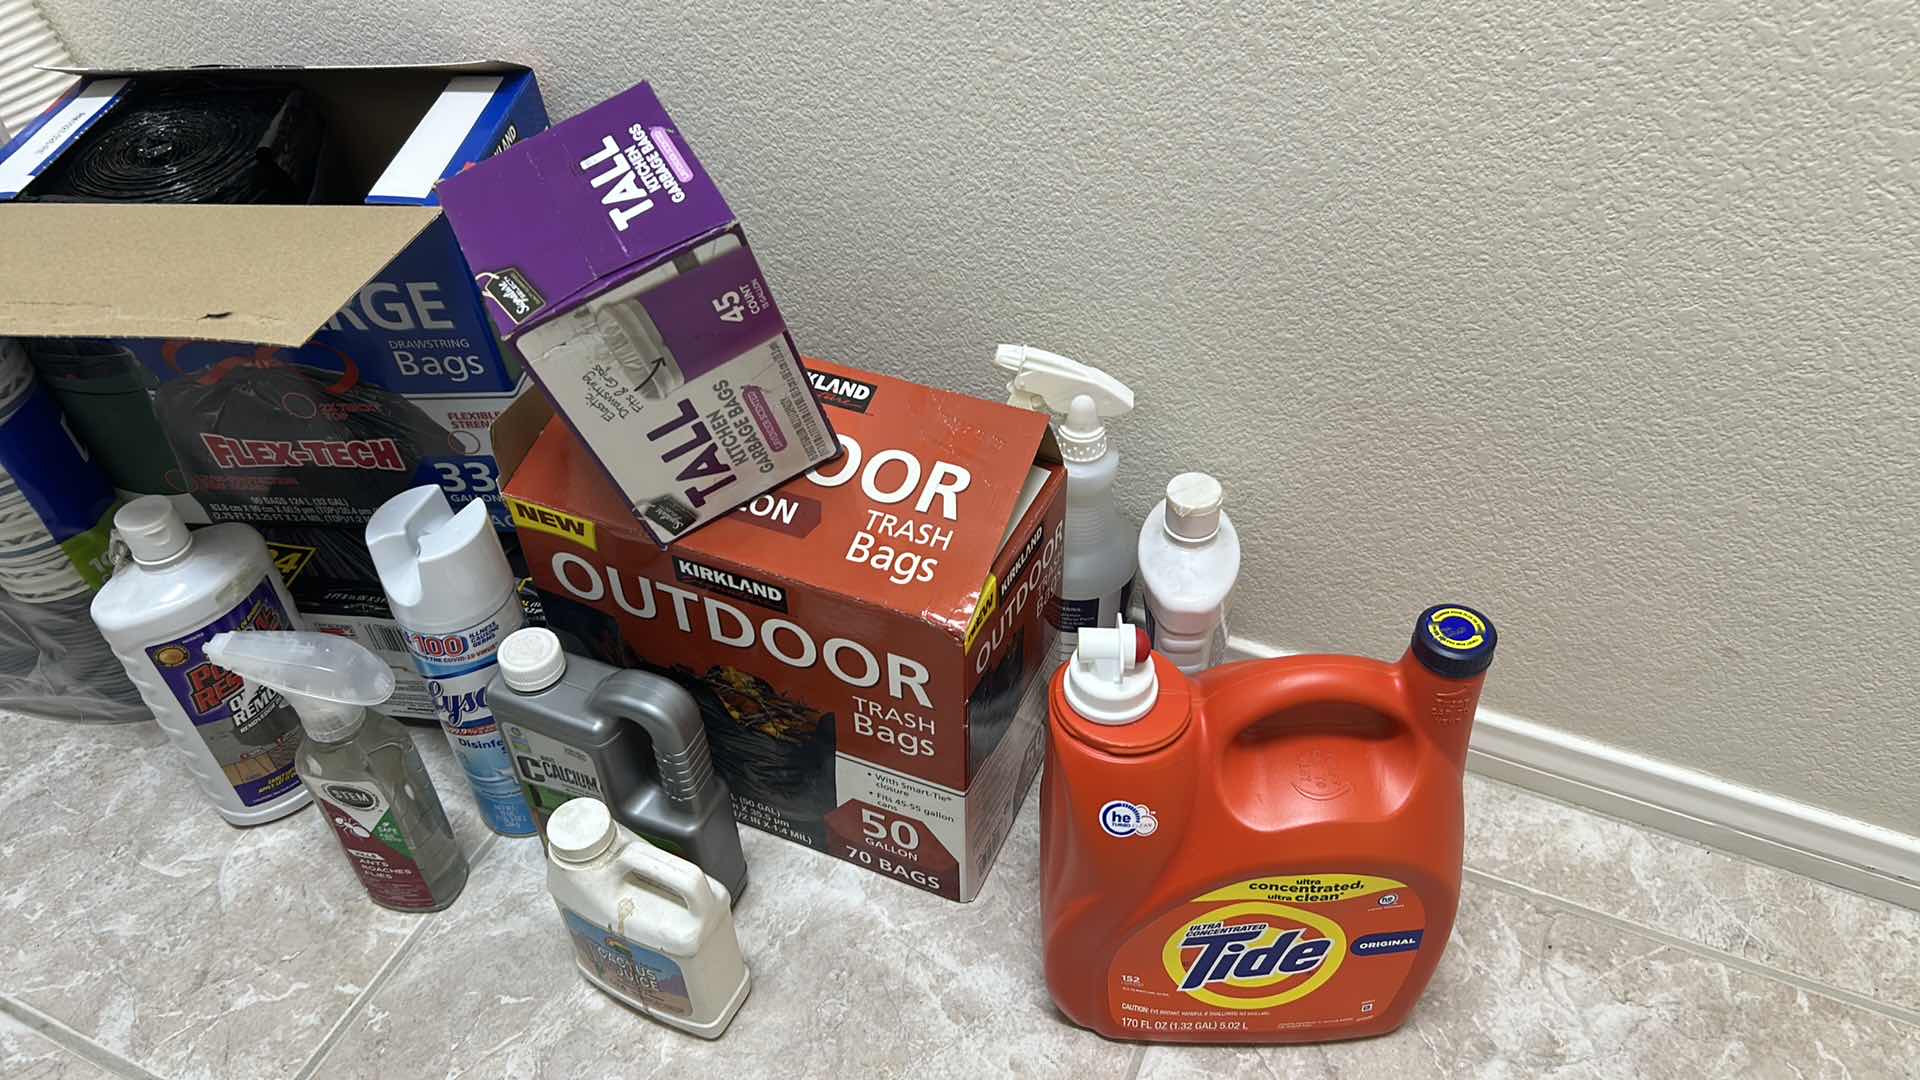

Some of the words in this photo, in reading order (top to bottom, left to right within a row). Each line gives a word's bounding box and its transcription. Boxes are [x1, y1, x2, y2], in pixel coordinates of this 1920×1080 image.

[628, 123, 662, 156] BAGS
[579, 135, 654, 231] TALL
[624, 145, 661, 194] KITCHEN
[643, 153, 686, 203] GARBAGE
[331, 282, 454, 331] RGE
[711, 290, 745, 326] 45
[738, 285, 761, 316] COUNT
[388, 338, 470, 350] DRAWSTRING
[393, 351, 485, 382] Bags
[593, 364, 622, 390] Grips
[581, 375, 630, 418] Drawstring
[584, 393, 615, 423] Elastic
[627, 393, 644, 413] Fits
[711, 378, 746, 414] BAGS
[451, 420, 490, 430] STREN
[199, 432, 405, 471] FLEX-TECH
[645, 397, 738, 508] TALL
[706, 409, 750, 474] KITCHEN
[732, 414, 776, 474] GARBAGE
[433, 461, 497, 493] 33
[514, 502, 585, 538] NEW
[866, 508, 954, 552] TRASH
[845, 530, 939, 585] Bags
[1001, 525, 1043, 596] KIRKLAND
[679, 559, 783, 602] KIRKLAND
[976, 519, 1063, 675] OUTDOOR
[550, 551, 934, 709] OUTDOOR
[968, 592, 994, 643] NEW
[414, 632, 469, 658] 100
[428, 680, 489, 727] Lyso
[851, 695, 937, 737] TRASH
[853, 712, 936, 760] Bags
[541, 761, 600, 793] CALCIUM
[874, 773, 899, 788] With
[874, 782, 910, 798] closure
[330, 789, 370, 805] STEM
[757, 802, 781, 817] GAL)
[877, 801, 898, 812] cans
[877, 792, 893, 803] Fits
[896, 796, 922, 812] 45-55
[923, 806, 955, 823] gallon
[861, 808, 919, 851] 50
[1112, 811, 1131, 823] he
[790, 830, 812, 845] MIL)
[865, 836, 918, 862] GALLON
[845, 845, 872, 865] 70
[879, 857, 941, 890] BAGS
[1296, 878, 1322, 886] ultra
[1249, 880, 1365, 894] concentrated,
[1267, 893, 1293, 902] ultra
[1186, 923, 1268, 937] CONCENTRATED
[1188, 923, 1223, 931] ULTRA
[1359, 938, 1417, 949] ORIGINAL
[1177, 928, 1336, 992] Tide
[1121, 974, 1141, 983] 152
[1121, 1017, 1139, 1028] 170
[1140, 1018, 1152, 1029] FL
[1154, 1021, 1168, 1030] OZ
[1169, 1021, 1193, 1031] (1.32
[1194, 1021, 1218, 1031] GAL)
[1219, 1021, 1240, 1031] 5.02
[1242, 1021, 1249, 1030] L
